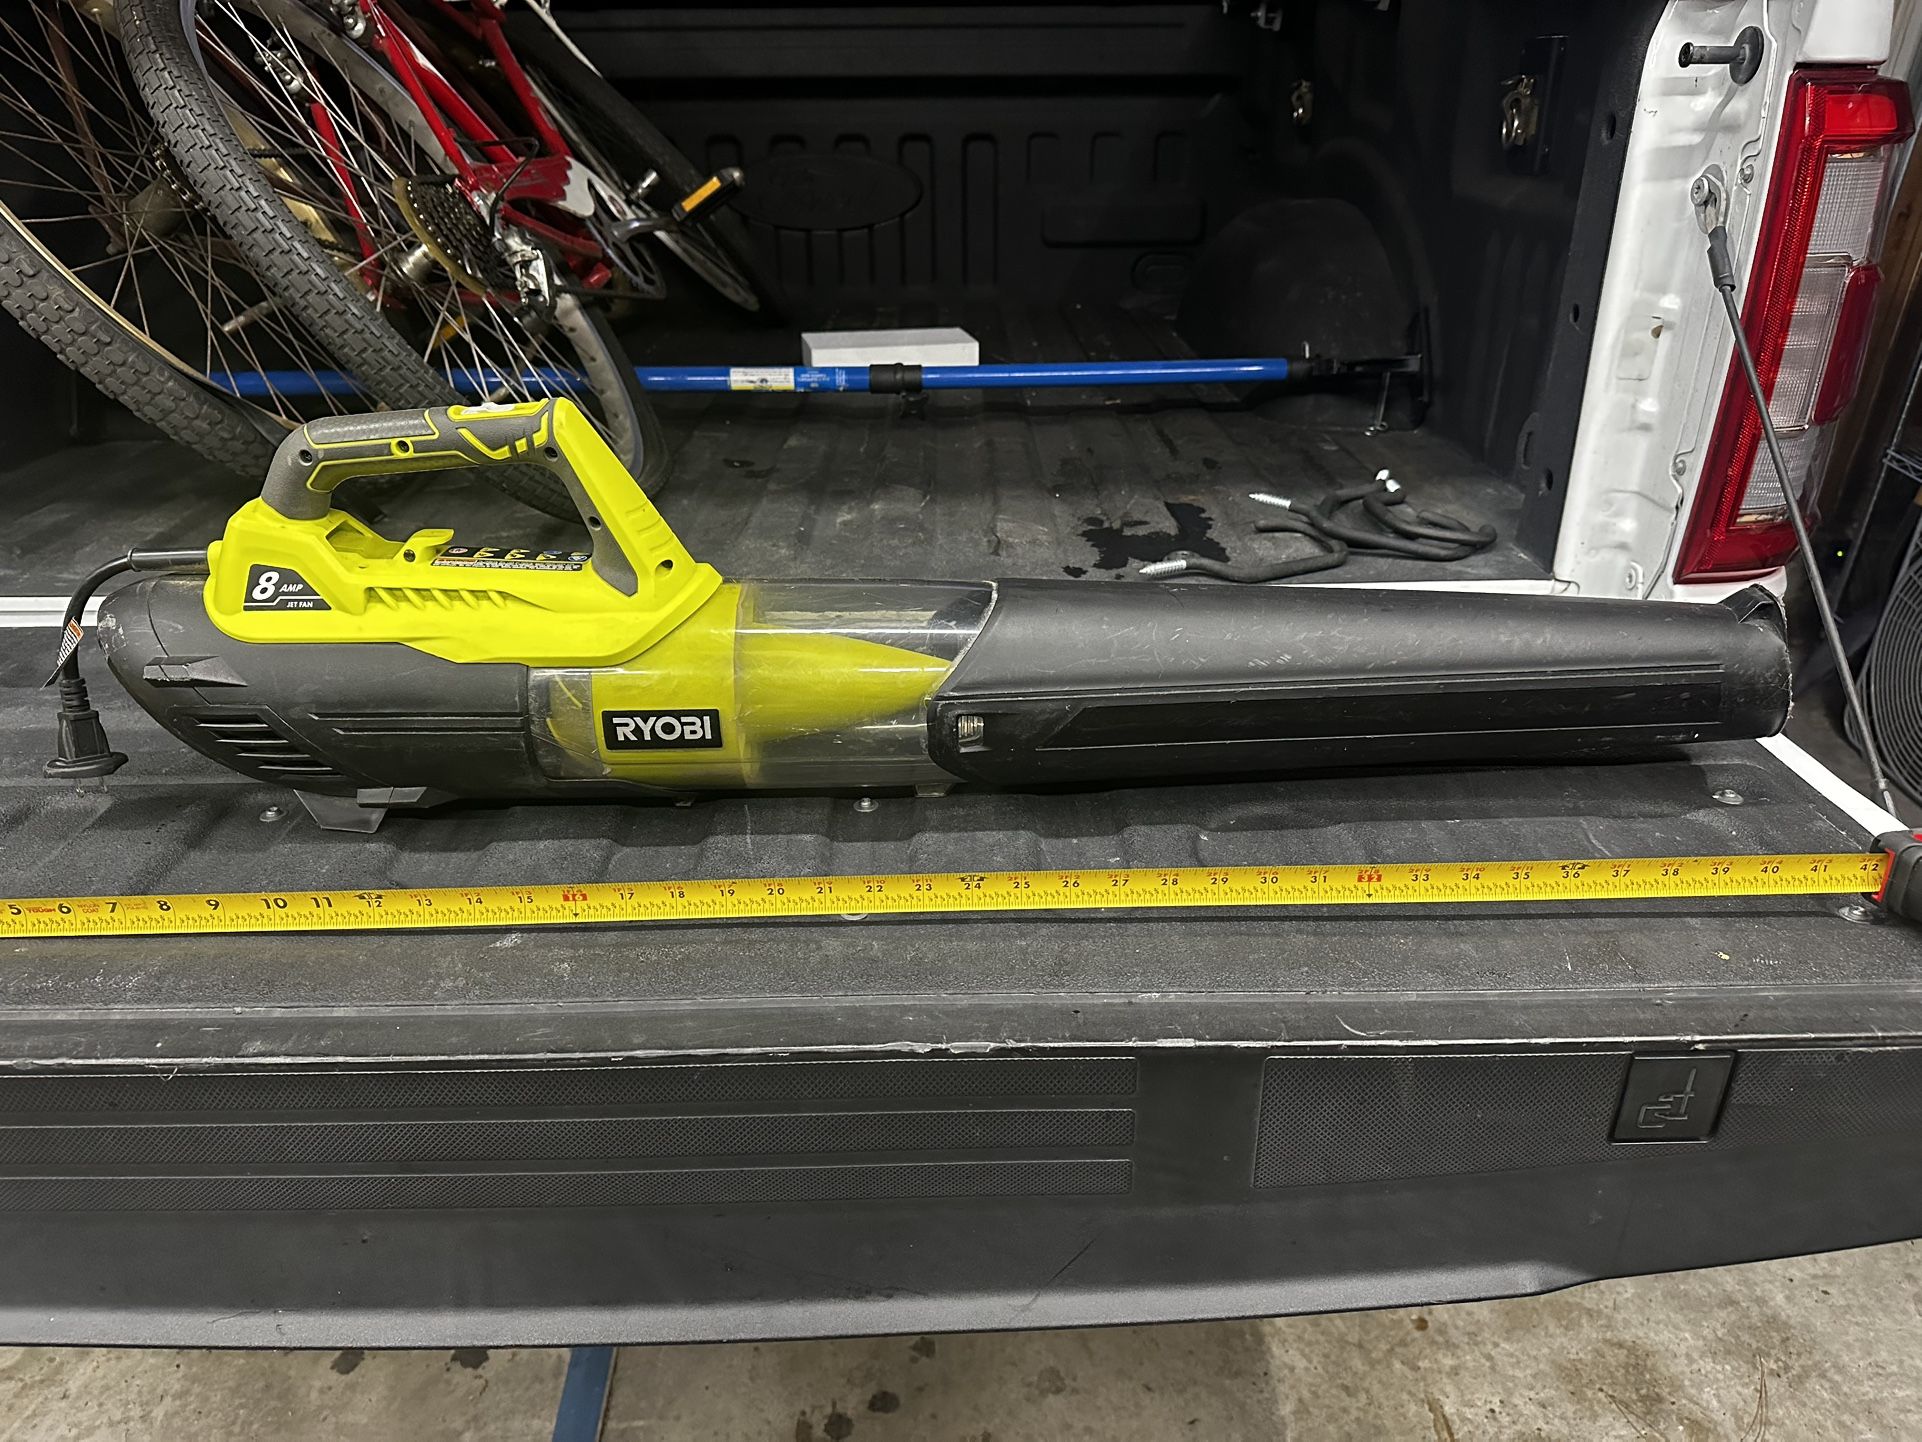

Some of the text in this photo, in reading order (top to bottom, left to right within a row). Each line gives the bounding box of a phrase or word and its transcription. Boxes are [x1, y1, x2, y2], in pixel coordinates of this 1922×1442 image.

[252, 571, 304, 600] 8 AMP
[612, 716, 713, 740] RYOBI
[8, 904, 21, 915] 5
[58, 903, 71, 914] 6
[105, 902, 118, 913] 7
[156, 900, 171, 911] 8
[205, 899, 220, 910] 9
[260, 898, 288, 910] 10
[310, 896, 333, 908] 11
[366, 900, 383, 908] 12
[416, 899, 433, 907] 13
[467, 897, 483, 905] 14
[517, 896, 533, 904] 15
[619, 892, 635, 900] 17
[720, 889, 735, 897] 19
[816, 886, 833, 894] 21
[866, 885, 884, 893] 22
[915, 883, 932, 891] 23
[1013, 881, 1030, 889] 25
[1062, 880, 1080, 888] 26
[1111, 879, 1129, 887] 27
[1161, 878, 1178, 886] 28
[1210, 877, 1229, 885] 29
[1260, 876, 1279, 884] 30
[1310, 875, 1327, 883] 31
[1462, 872, 1480, 880] 34
[1512, 871, 1530, 879] 35
[1562, 870, 1580, 878] 36
[1612, 869, 1630, 877] 37
[1661, 868, 1679, 876] 38
[1711, 867, 1730, 875] 39
[1760, 866, 1779, 874] 40
[1810, 865, 1828, 873] 41
[1860, 863, 1879, 871] 42
